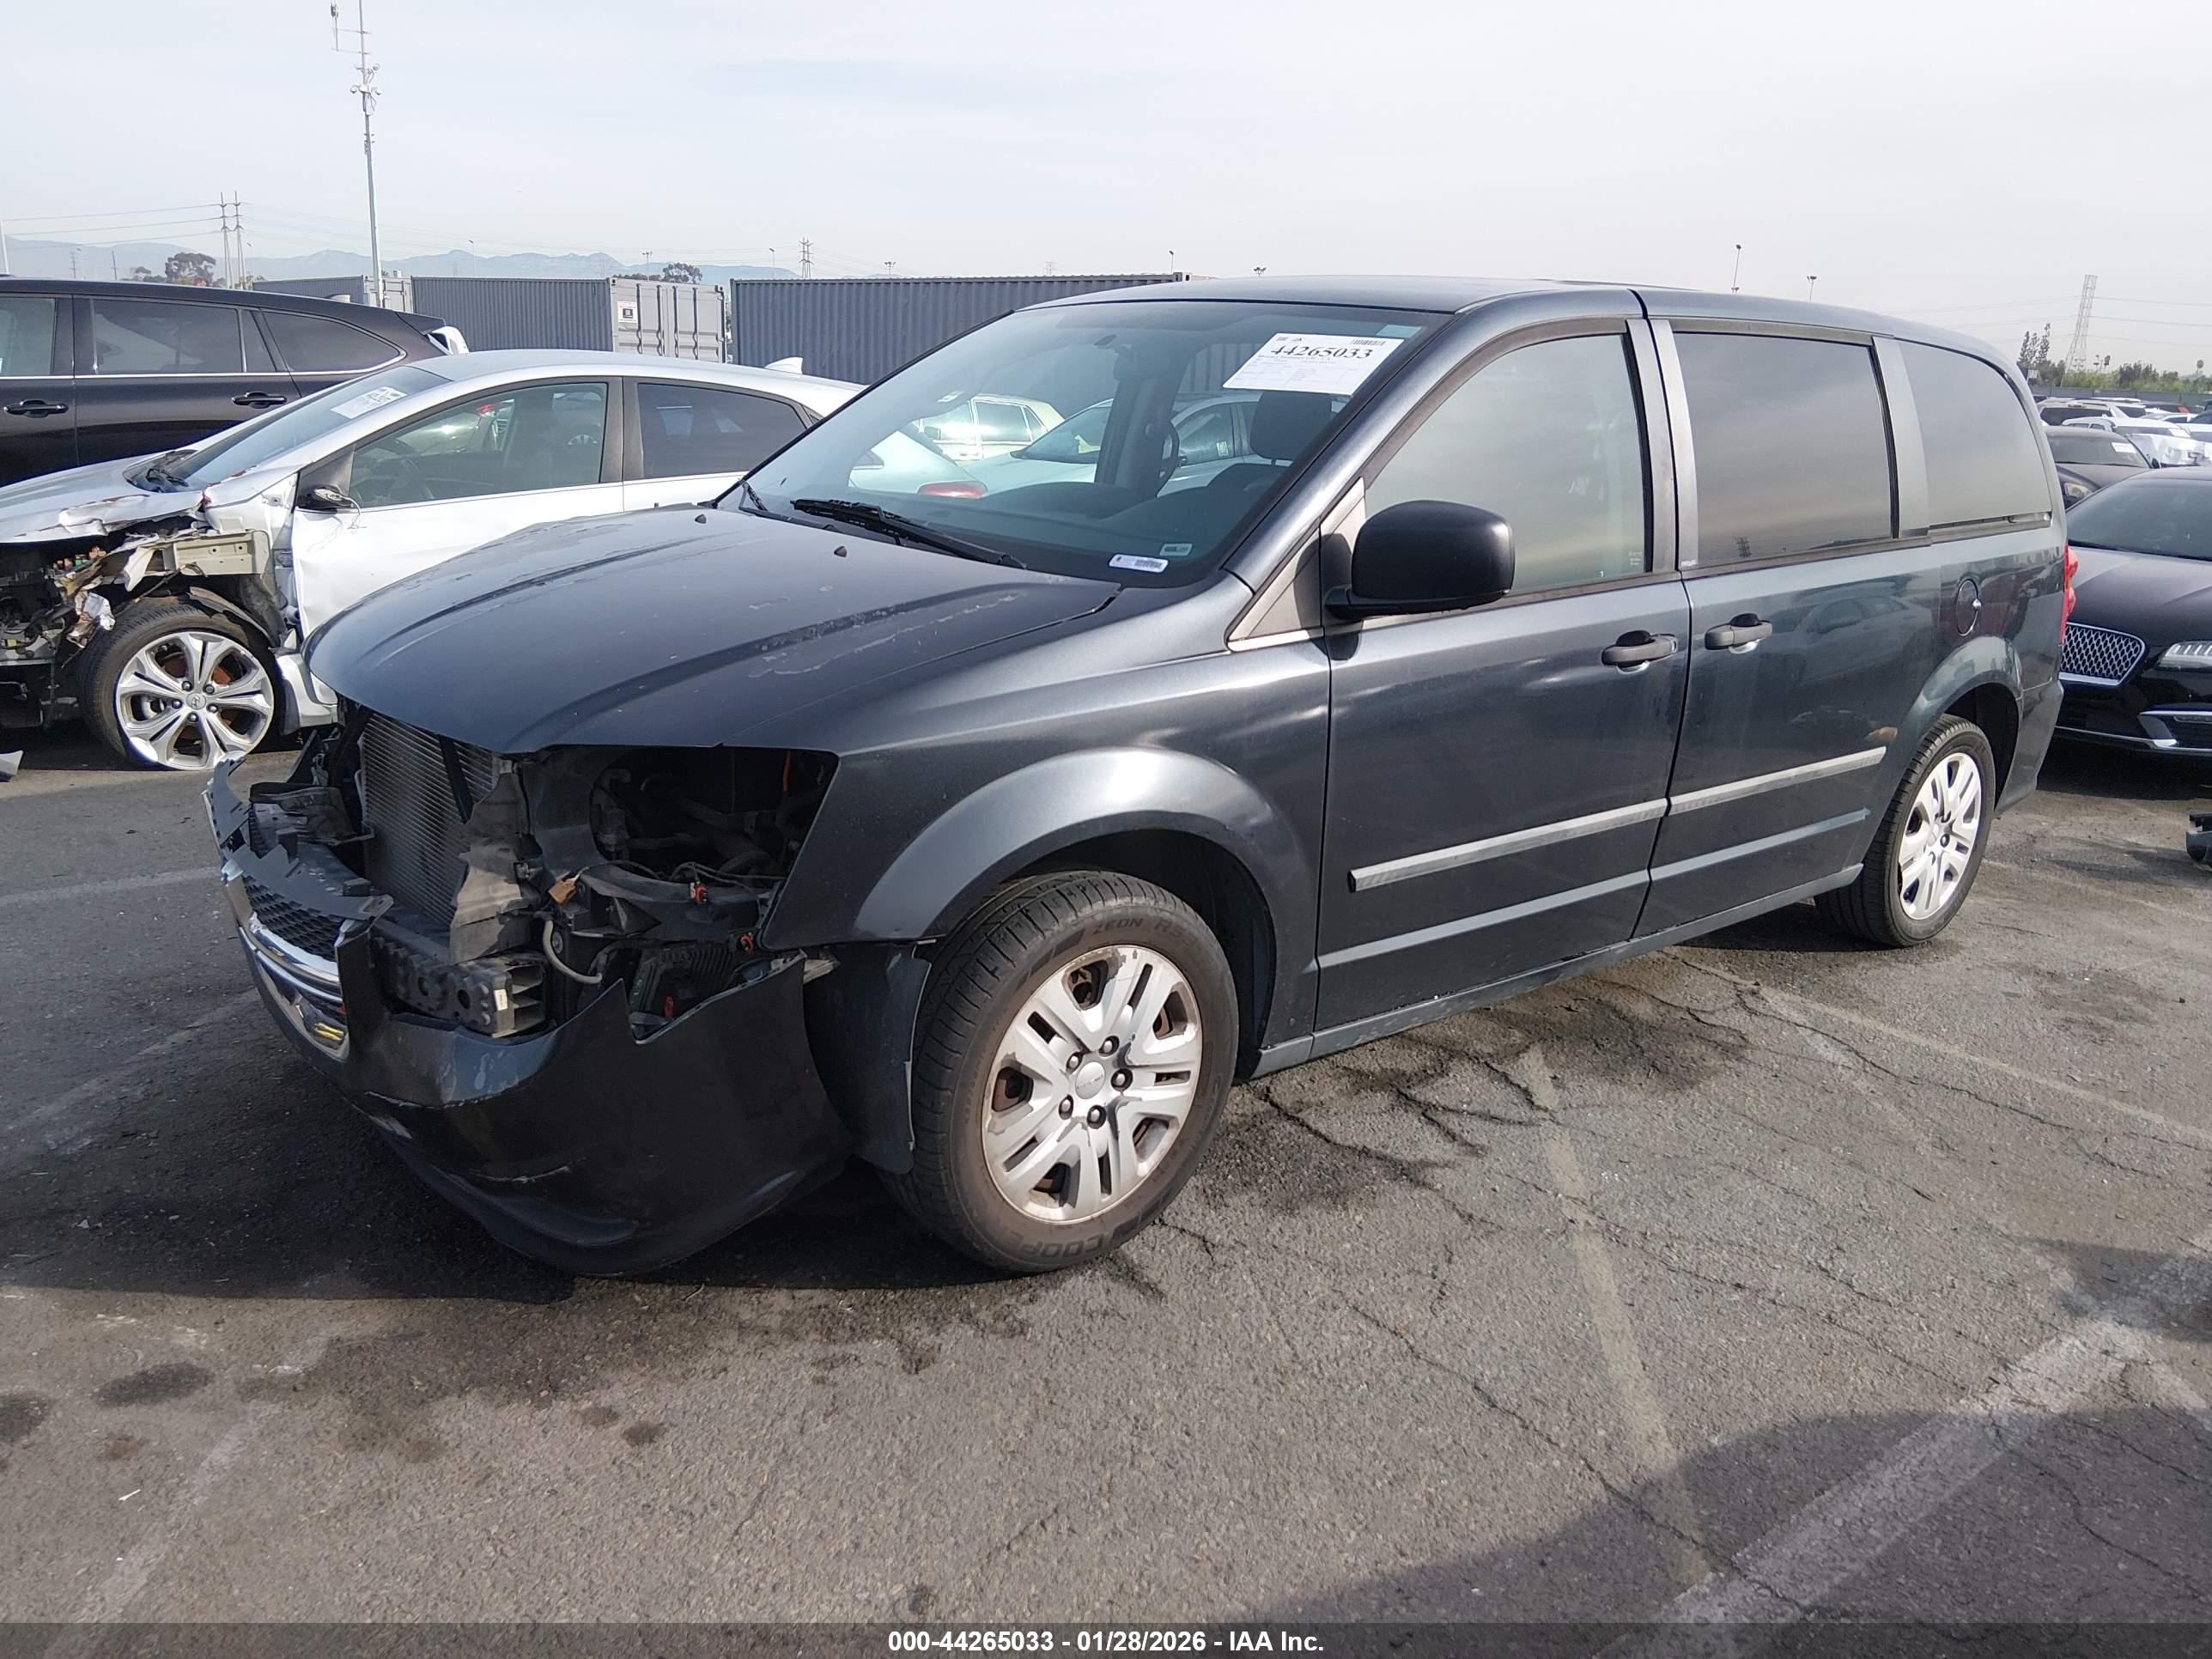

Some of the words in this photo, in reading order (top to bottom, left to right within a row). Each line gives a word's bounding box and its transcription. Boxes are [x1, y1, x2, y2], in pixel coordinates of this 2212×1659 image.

[1271, 345, 1374, 359] 44265033
[1093, 918, 1143, 935] ZEON
[1002, 1228, 1103, 1259] COOPE
